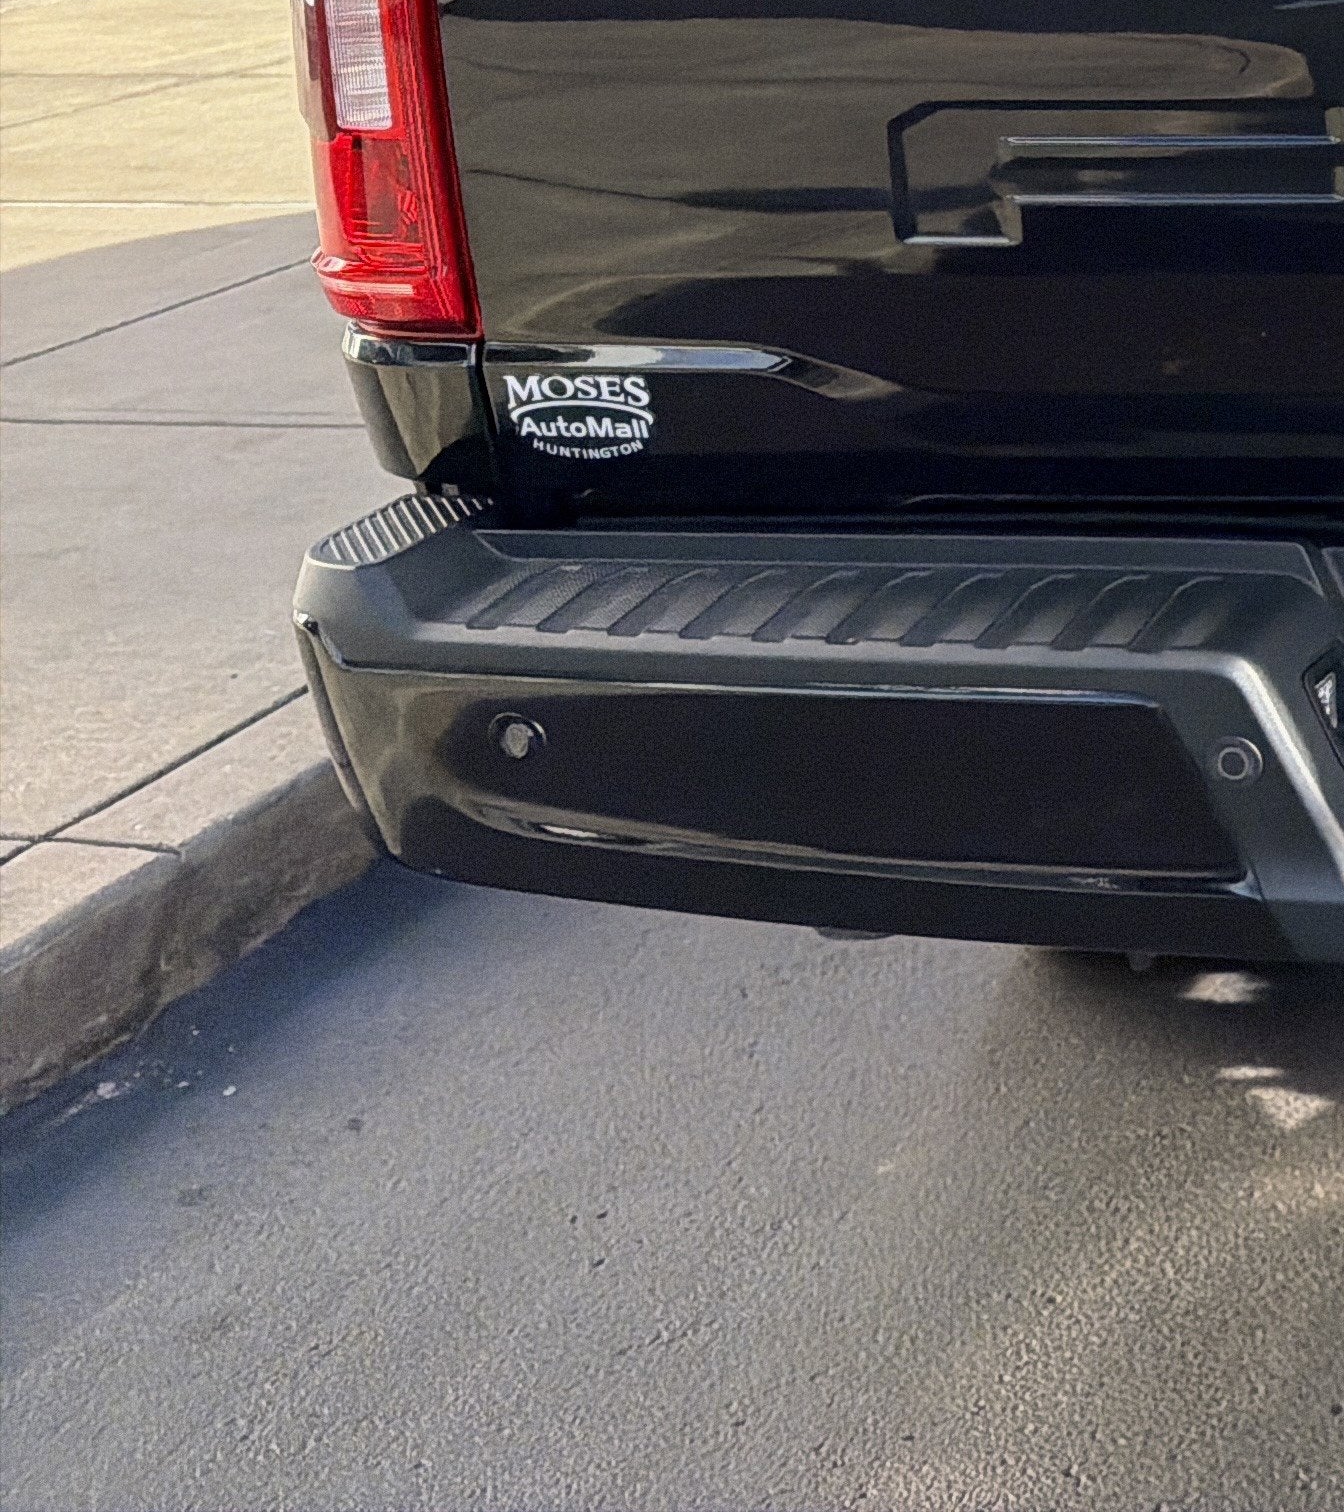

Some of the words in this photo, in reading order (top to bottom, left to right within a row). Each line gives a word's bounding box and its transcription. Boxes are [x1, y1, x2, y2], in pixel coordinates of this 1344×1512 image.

[502, 374, 651, 411] MOSES
[520, 415, 650, 439] AutoMall
[532, 437, 644, 460] HUNTINGTON
